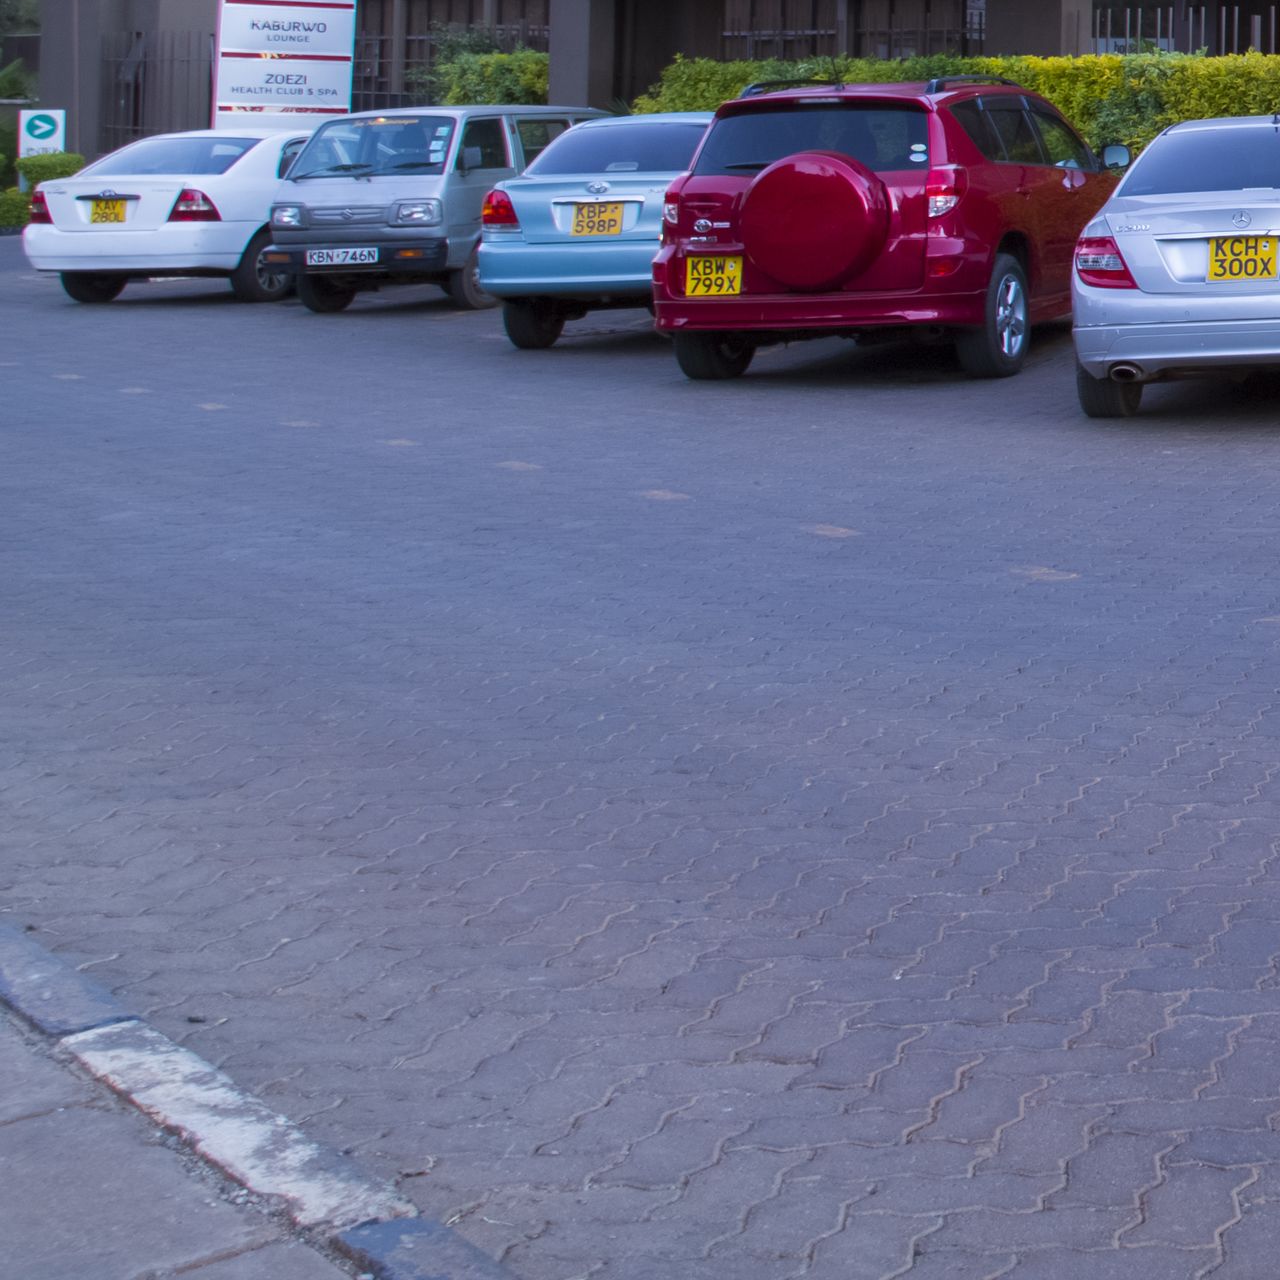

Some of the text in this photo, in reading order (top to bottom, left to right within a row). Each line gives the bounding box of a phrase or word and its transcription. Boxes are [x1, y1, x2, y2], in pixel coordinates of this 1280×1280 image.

[251, 20, 328, 34] KABURWO
[267, 34, 311, 43] LOUNGE
[265, 73, 308, 86] ZOEZI
[231, 86, 273, 95] HEALTH
[276, 87, 304, 96] CLUB
[317, 88, 339, 97] SPA
[576, 204, 608, 219] KBP
[575, 219, 618, 234] 598P
[1215, 238, 1259, 257] KCH
[309, 250, 376, 263] KBN 746N
[691, 259, 726, 277] KBW
[1214, 257, 1272, 277] 300X
[691, 276, 736, 294] 799X
